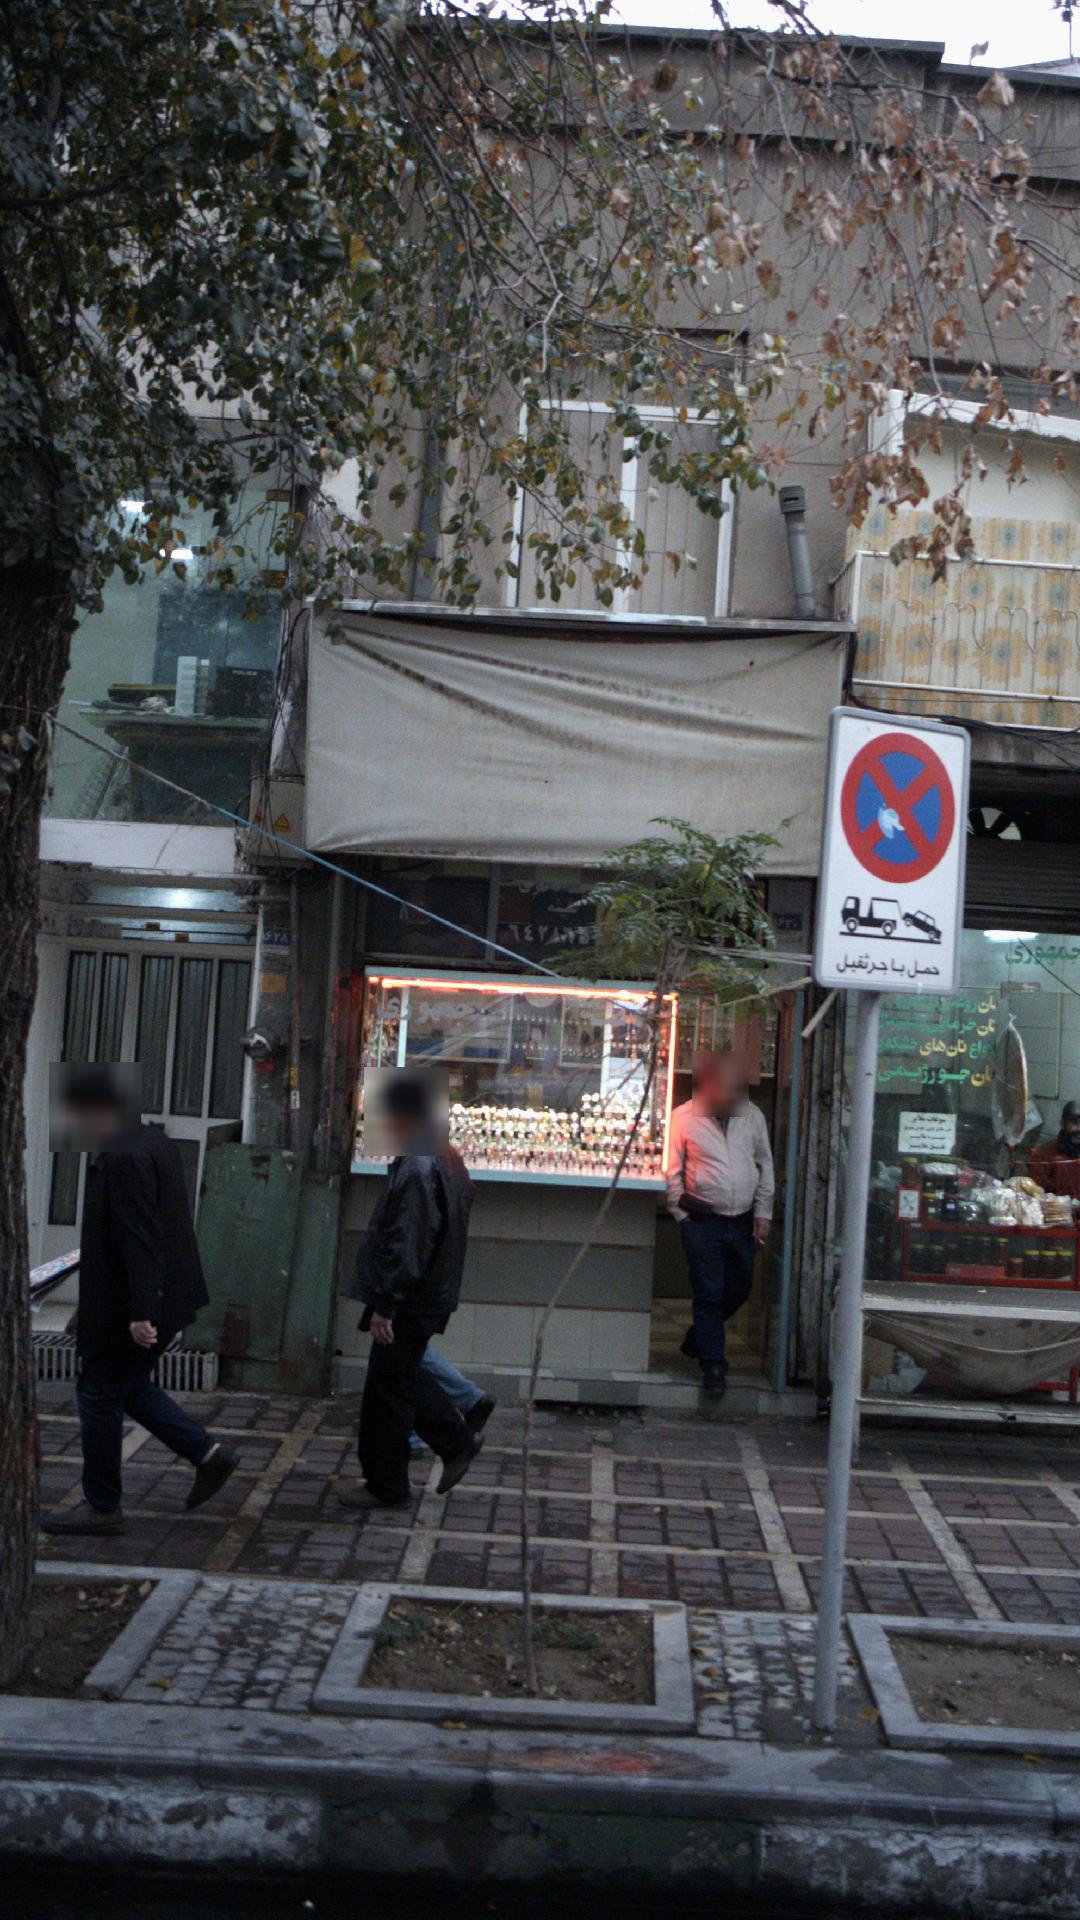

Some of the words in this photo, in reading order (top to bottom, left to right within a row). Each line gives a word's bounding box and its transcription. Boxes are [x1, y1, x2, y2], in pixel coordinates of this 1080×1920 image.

[836, 952, 888, 974] جرثقیل
[890, 958, 905, 973] با
[907, 960, 940, 978] حمل
[976, 1017, 996, 1036] نان
